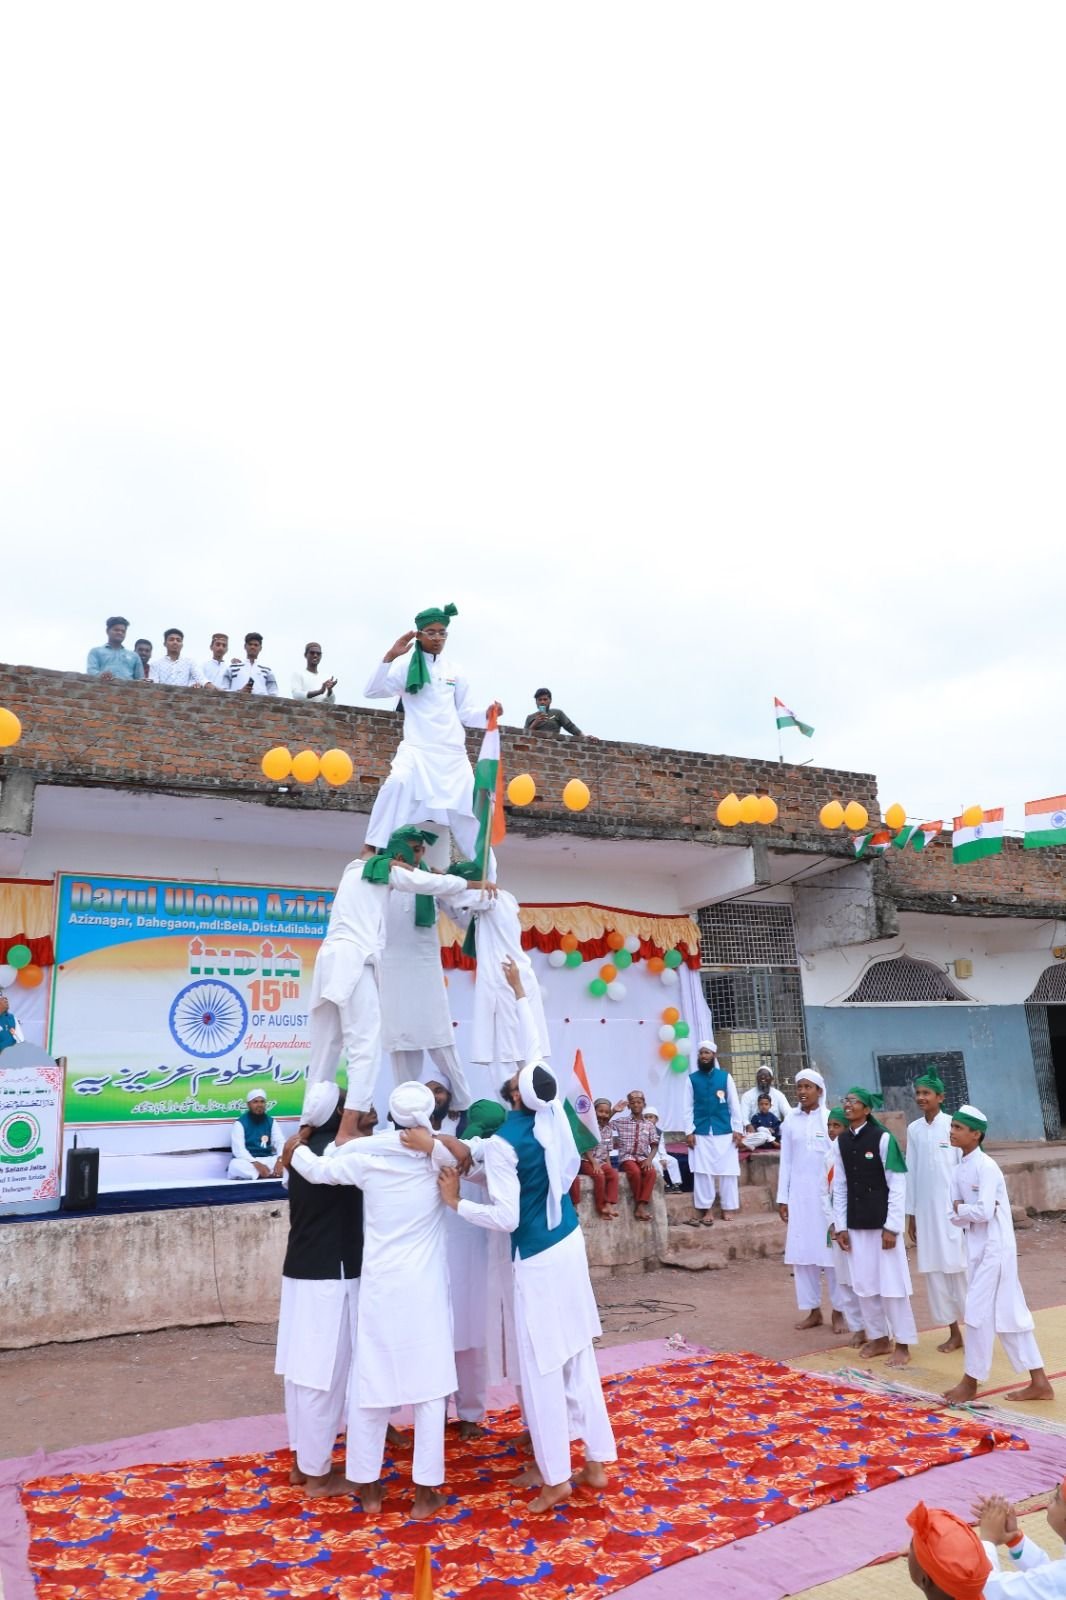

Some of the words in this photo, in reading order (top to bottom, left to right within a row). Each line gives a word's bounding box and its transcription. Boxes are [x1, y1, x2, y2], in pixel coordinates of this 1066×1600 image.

[71, 881, 158, 914] Darul
[165, 887, 259, 919] Uloom
[68, 912, 133, 928] Aziznagar,
[189, 937, 301, 978] INDIA
[248, 979, 300, 1012] 15th
[252, 1014, 266, 1027] OF
[268, 1014, 309, 1026] AUGUST
[244, 1034, 312, 1055] Independenc
